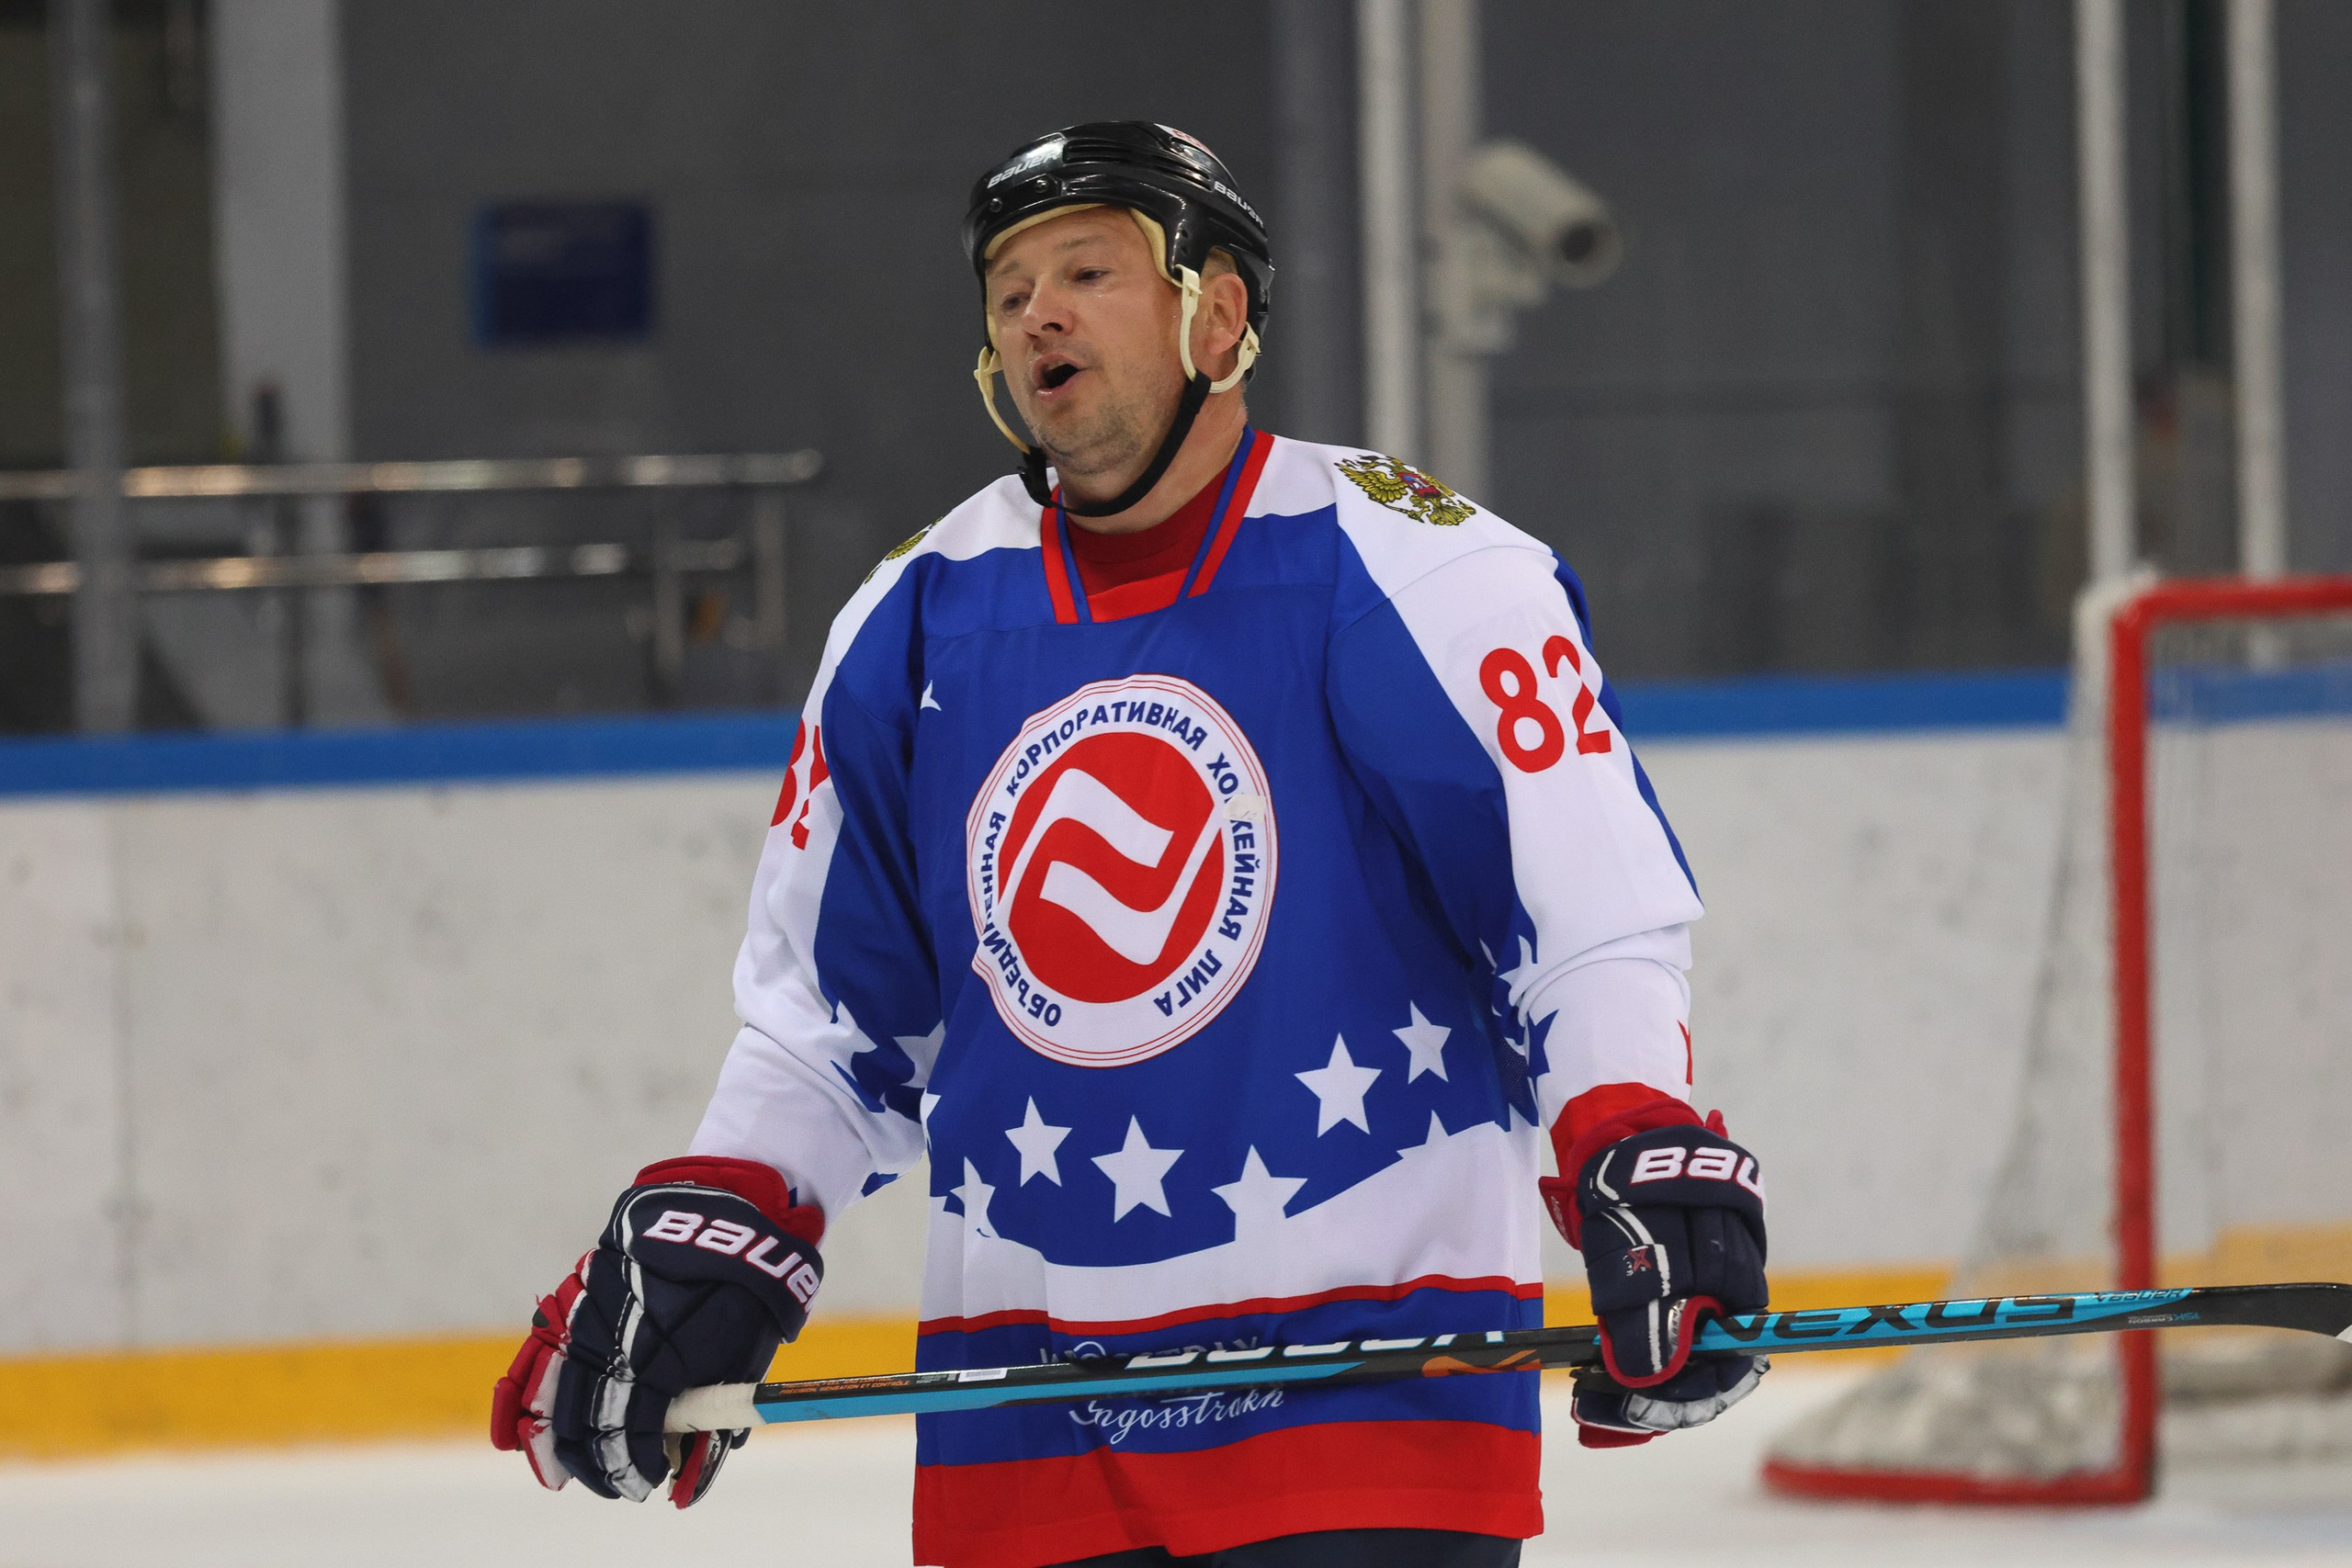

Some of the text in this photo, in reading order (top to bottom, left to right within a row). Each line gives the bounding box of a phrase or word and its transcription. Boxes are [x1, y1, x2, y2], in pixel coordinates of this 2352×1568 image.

[1006, 701, 1208, 798] КОРПОРАТИВНАЯ
[1479, 635, 1611, 773] 82
[1206, 751, 1261, 942] ХОКЕЙНАЯ
[1153, 948, 1223, 1017] ЛИГА
[1629, 1146, 1766, 1209] BAU
[641, 1210, 821, 1314] BAUE
[1692, 1294, 2075, 1346] NEXUS
